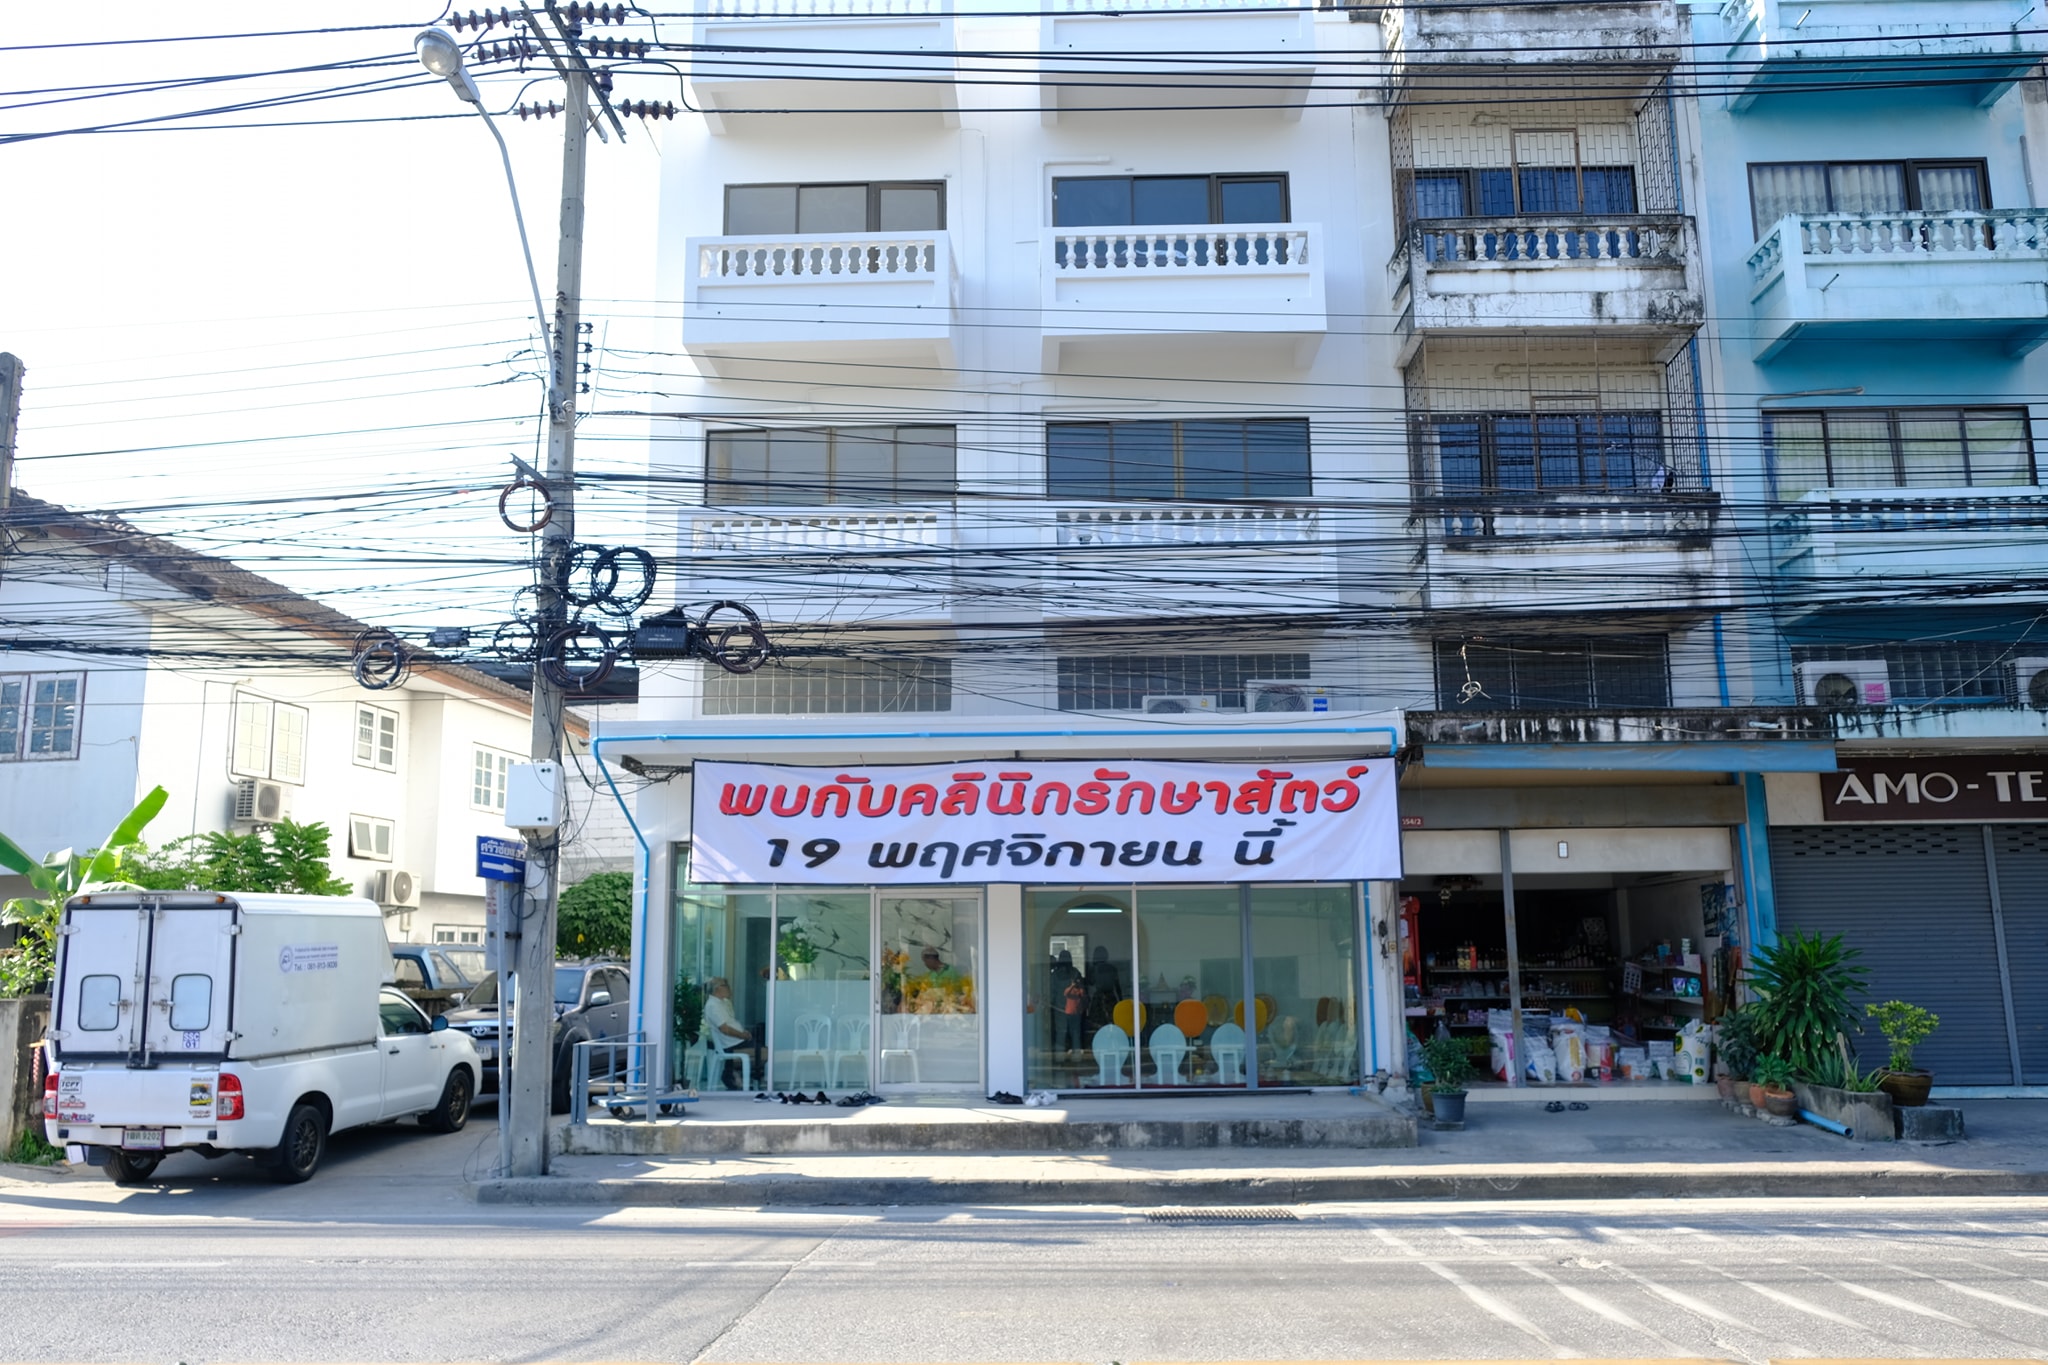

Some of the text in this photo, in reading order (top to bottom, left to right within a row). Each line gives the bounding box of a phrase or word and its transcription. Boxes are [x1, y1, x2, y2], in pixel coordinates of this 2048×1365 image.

[719, 765, 1368, 817] พบกับคลินิกรักษาสัตว์
[767, 818, 1297, 879] 19 พฤศจิกายน นี้
[183, 1032, 199, 1041] SSC
